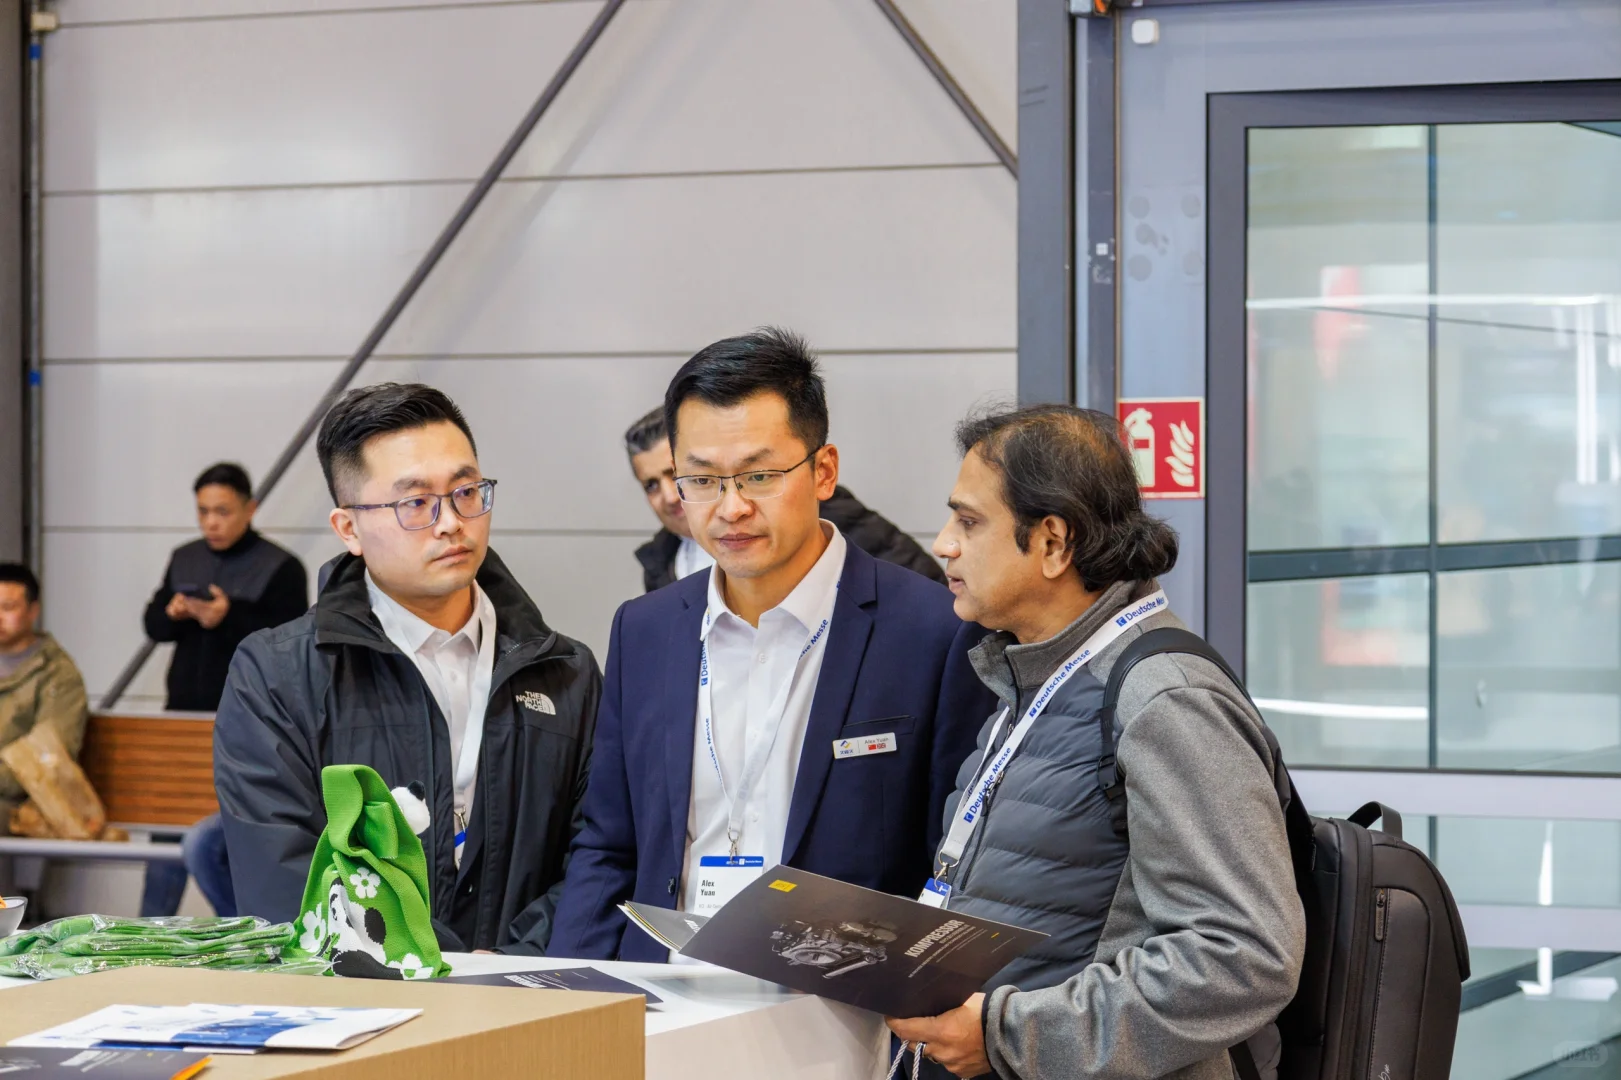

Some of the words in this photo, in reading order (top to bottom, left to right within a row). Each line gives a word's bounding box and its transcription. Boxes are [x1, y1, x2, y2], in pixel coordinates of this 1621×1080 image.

[1124, 601, 1157, 621] Deutsche
[811, 619, 828, 645] Messe
[1035, 671, 1067, 709] Deutsche
[1064, 649, 1091, 672] Messe
[515, 694, 543, 706] NORTH
[525, 690, 541, 699] THE
[991, 747, 1012, 775] Messe
[701, 879, 716, 888] Alex
[904, 919, 965, 958] KOMPRESSOR
